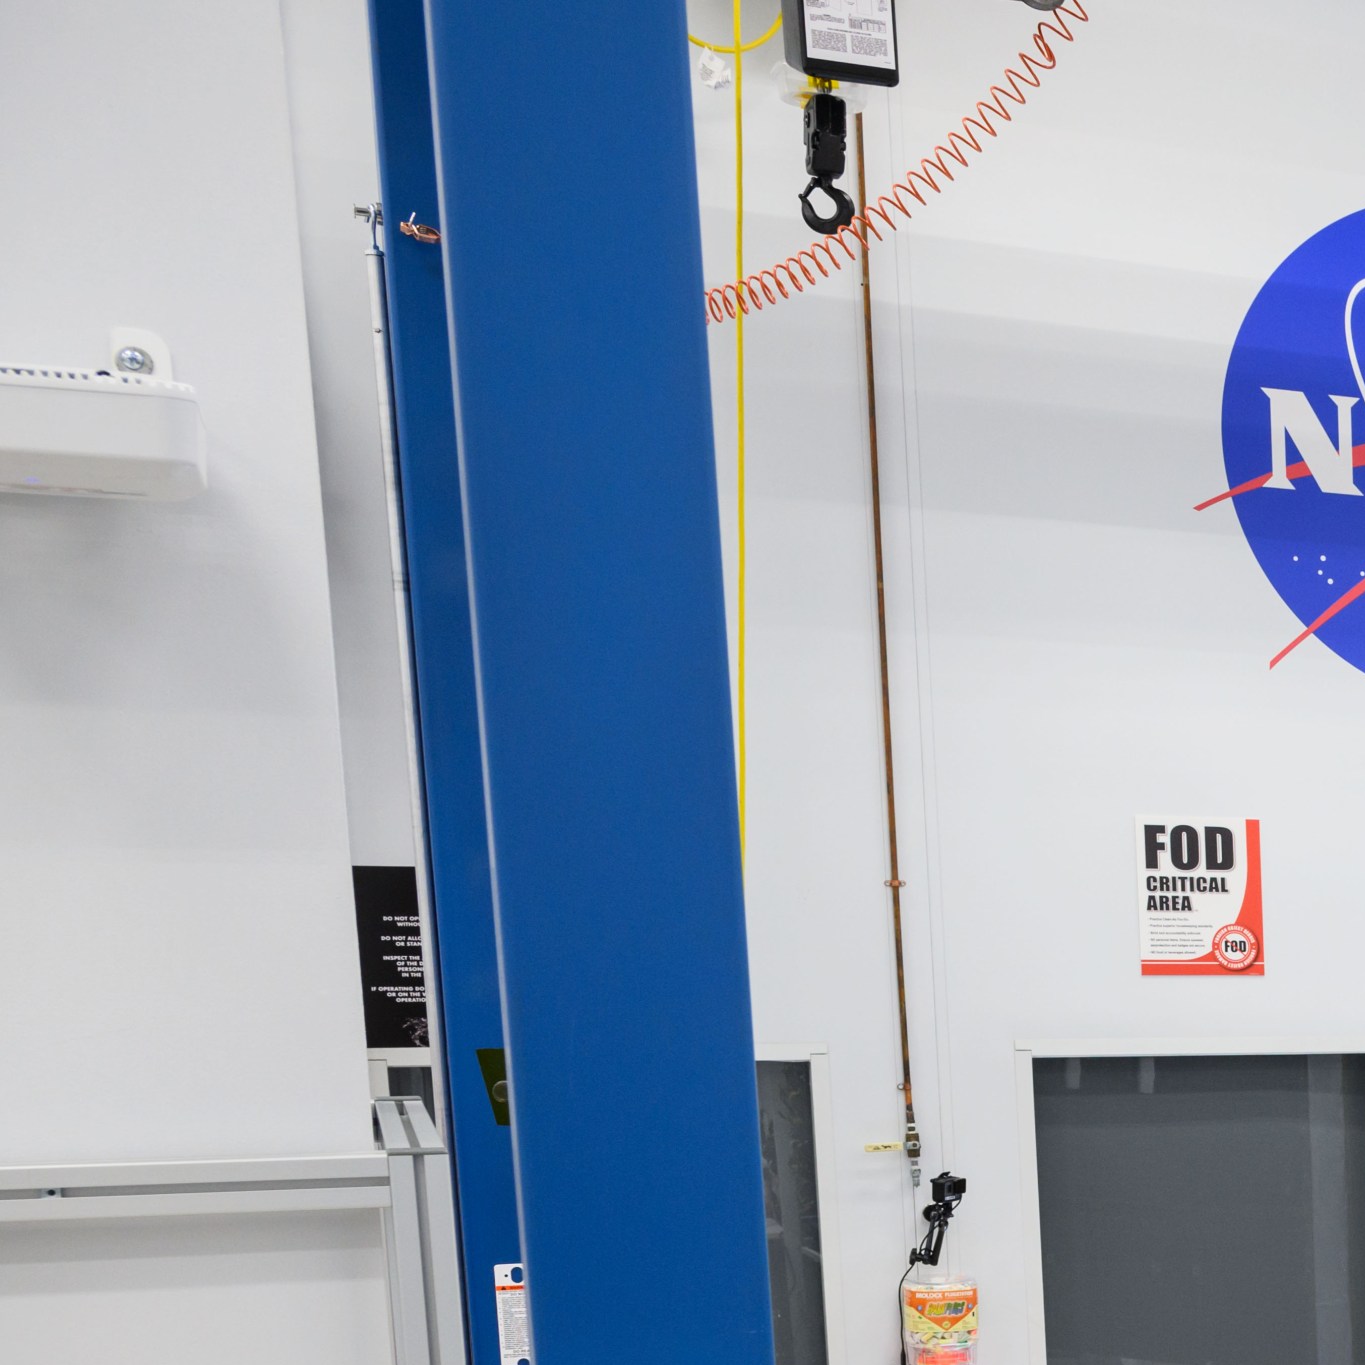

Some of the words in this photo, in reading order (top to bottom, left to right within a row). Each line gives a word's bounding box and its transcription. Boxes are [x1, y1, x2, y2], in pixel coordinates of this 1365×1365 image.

[1144, 824, 1235, 871] FOD
[1146, 875, 1229, 892] CRITICAL
[1146, 895, 1193, 911] AREA
[1224, 940, 1247, 953] FOD
